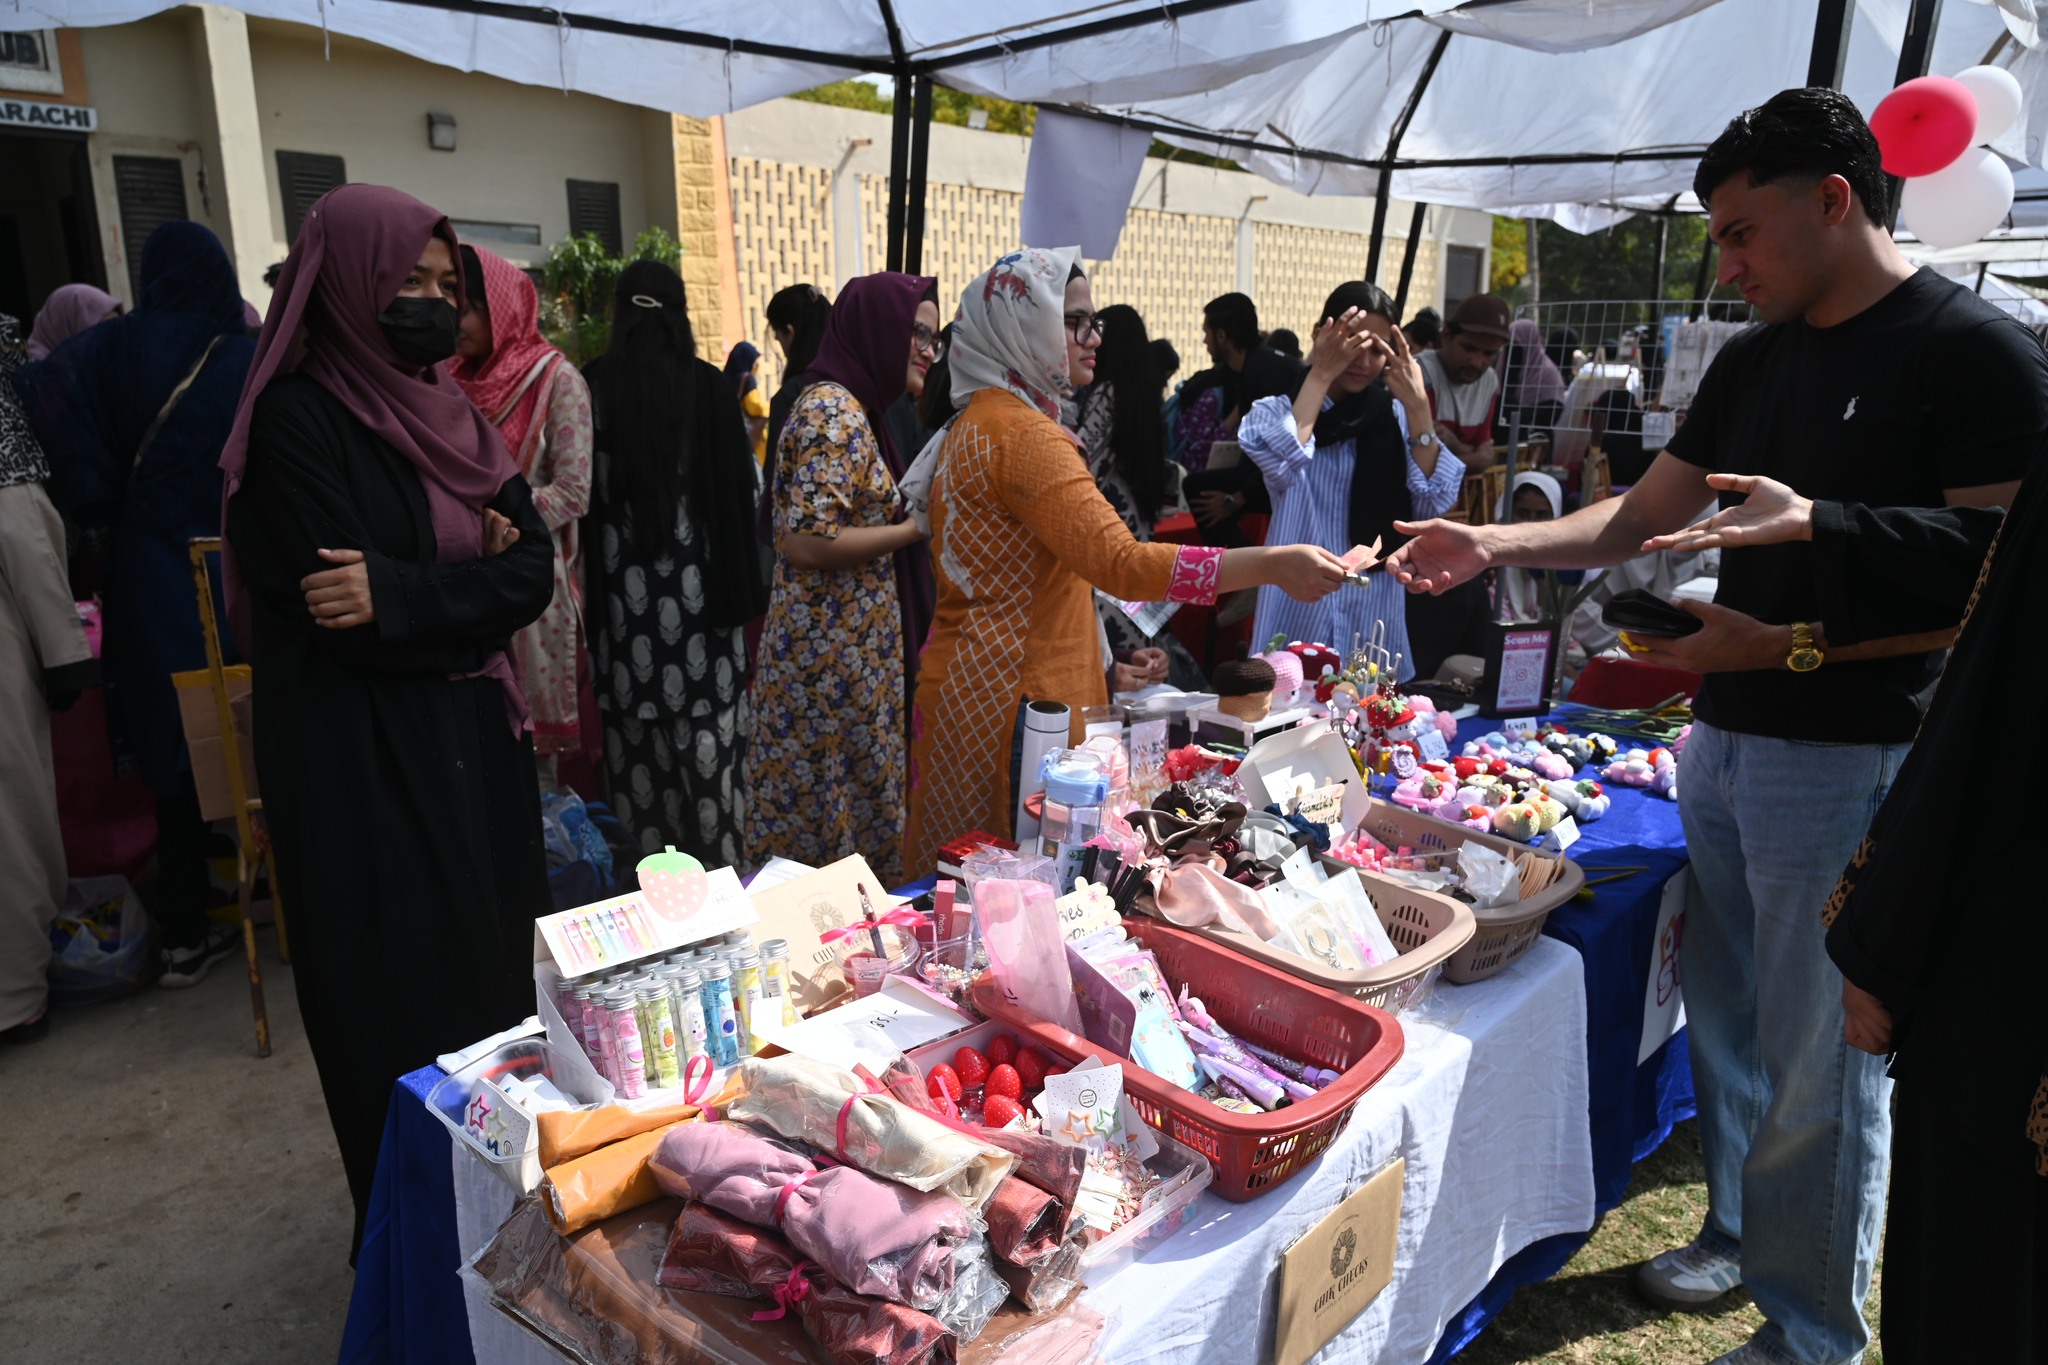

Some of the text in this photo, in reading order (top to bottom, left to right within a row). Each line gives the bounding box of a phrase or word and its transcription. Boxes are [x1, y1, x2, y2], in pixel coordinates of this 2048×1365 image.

[1504, 633, 1549, 645] Scan Me
[938, 913, 947, 935] rhode
[1314, 1284, 1337, 1313] CHIK
[1338, 1256, 1369, 1292] CHECKS
